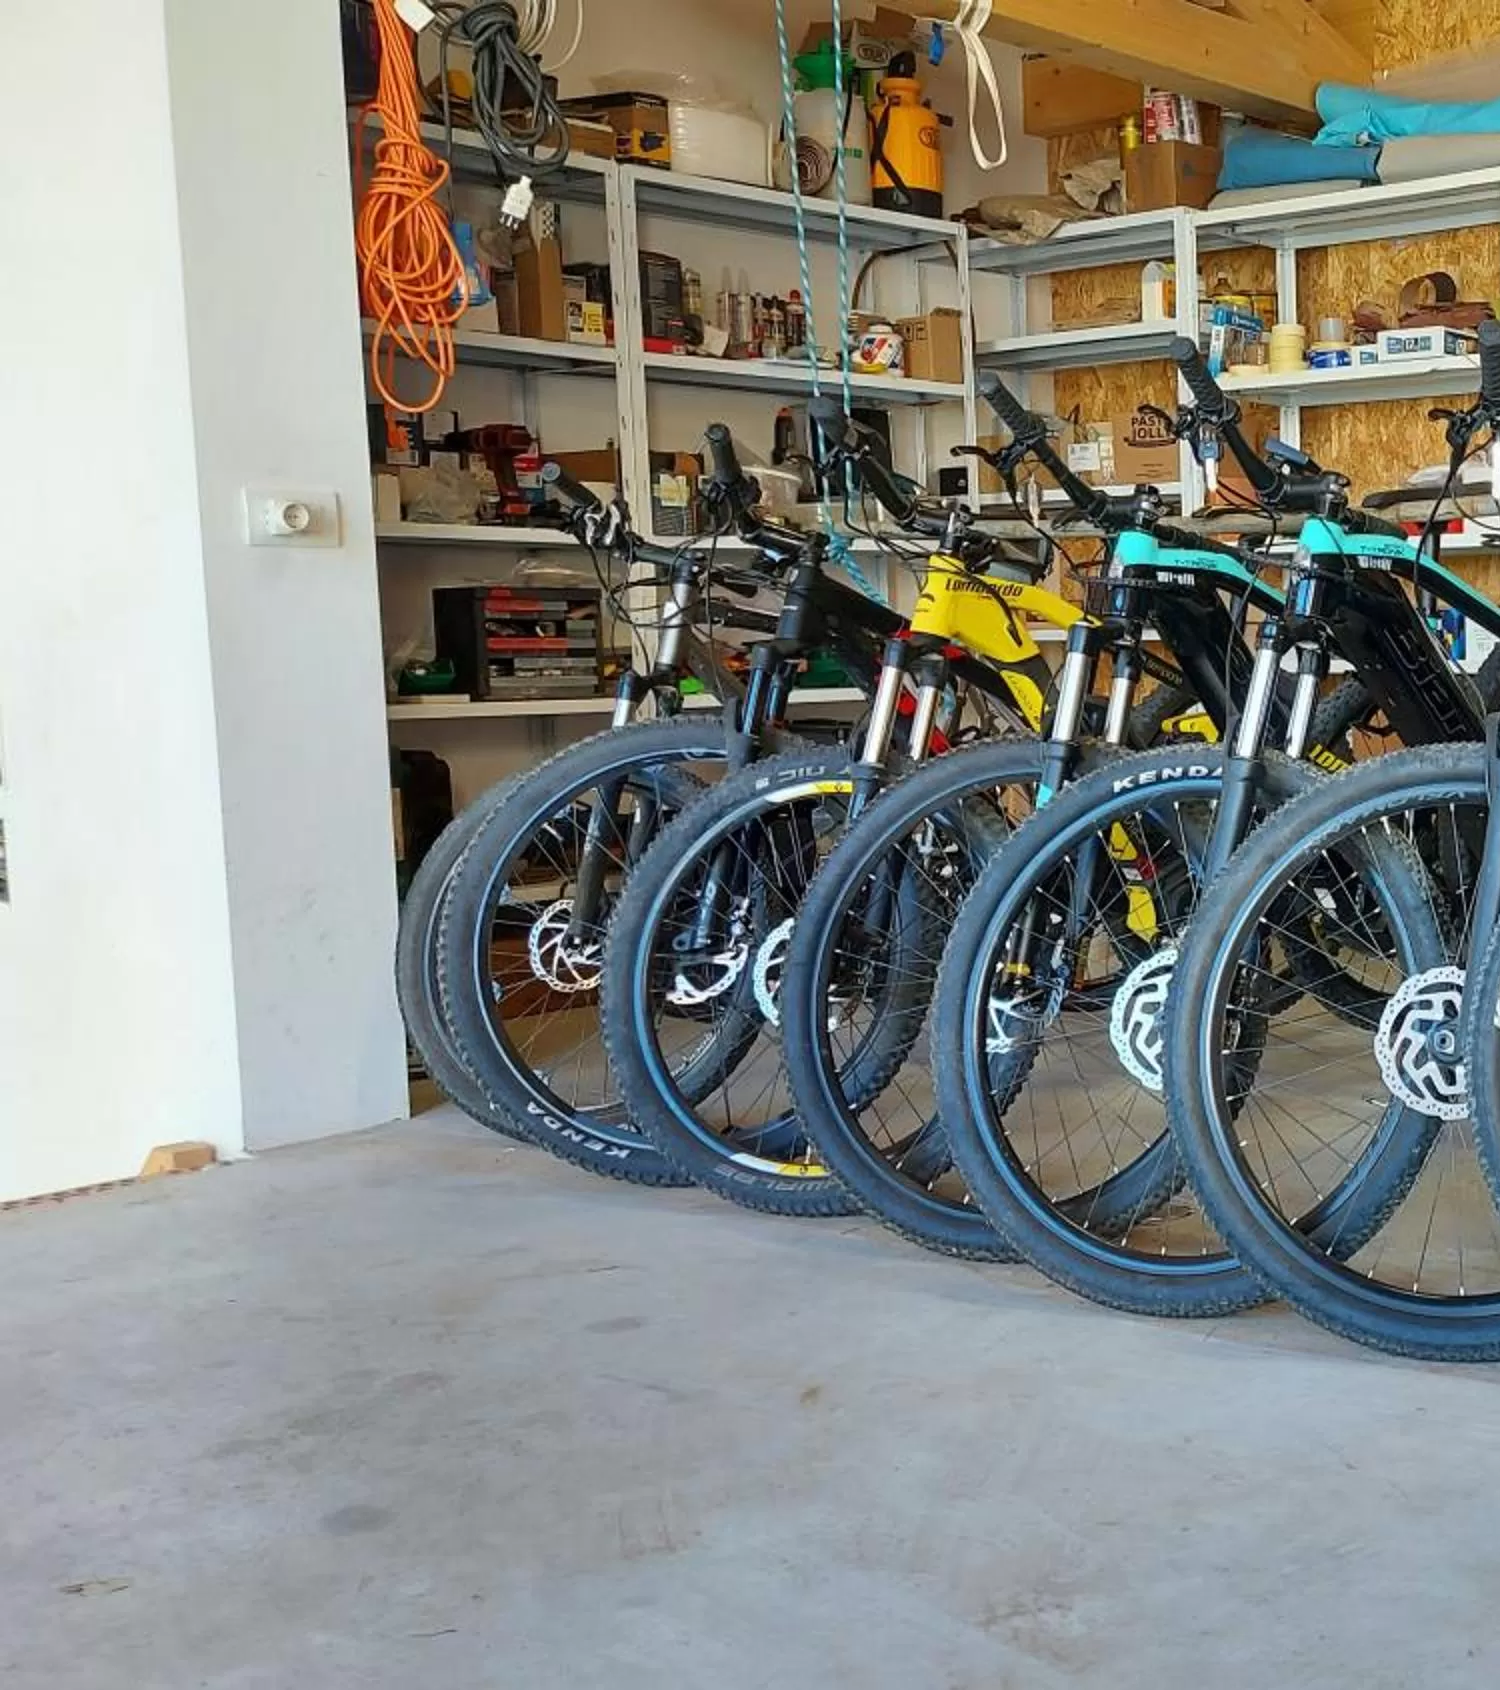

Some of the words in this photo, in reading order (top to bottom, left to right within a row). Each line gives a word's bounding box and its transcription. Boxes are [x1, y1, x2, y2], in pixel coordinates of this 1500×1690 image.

[1131, 415, 1163, 427] PAST
[1132, 427, 1166, 442] JOLL
[945, 578, 1023, 597] Lombrdo
[527, 1101, 631, 1159] KENDA
[713, 1163, 832, 1192] WALBE
